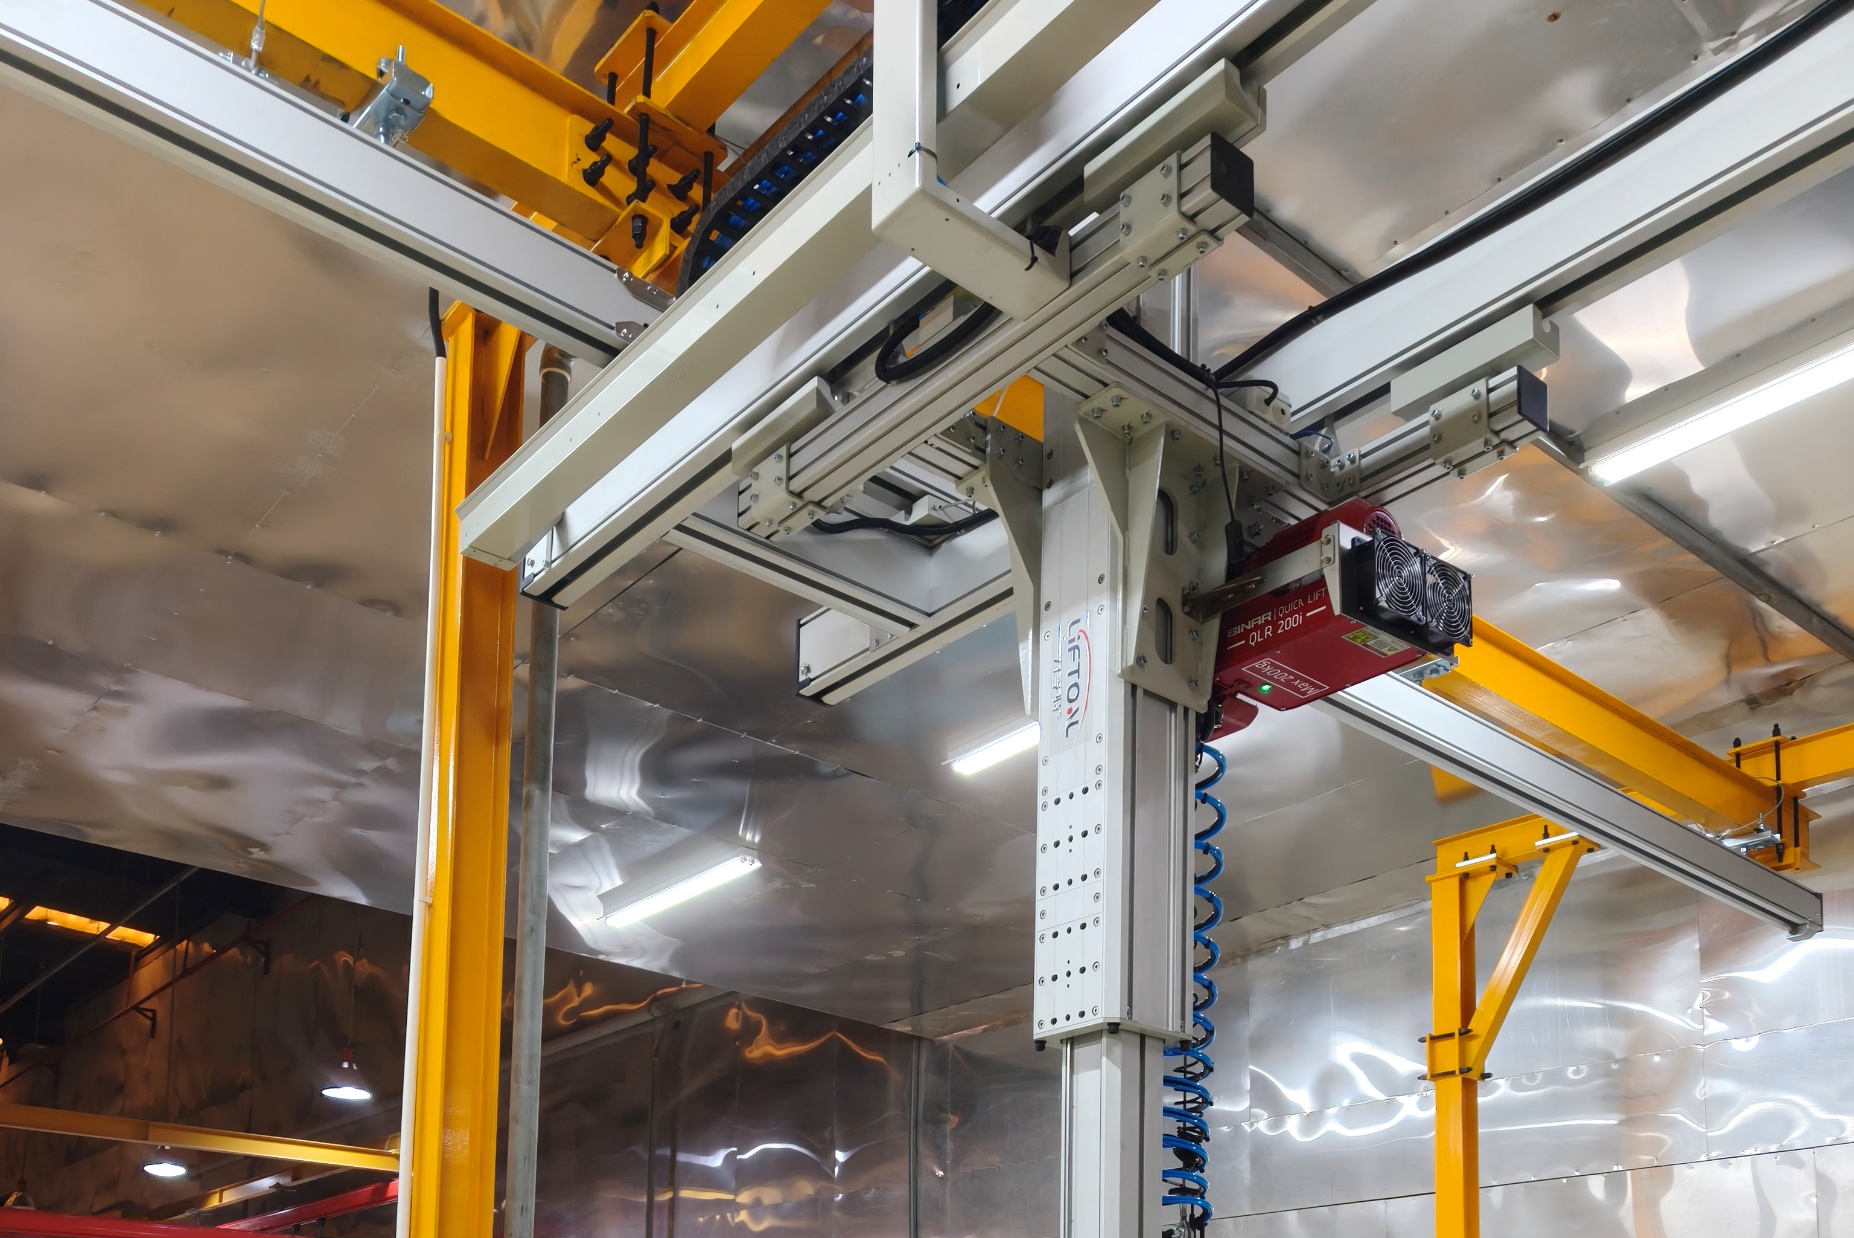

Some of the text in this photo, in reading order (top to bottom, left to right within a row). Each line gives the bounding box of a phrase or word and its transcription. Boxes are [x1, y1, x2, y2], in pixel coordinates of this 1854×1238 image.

[1278, 598, 1305, 617] QUICK
[1307, 587, 1327, 604] LIFT
[1249, 612, 1303, 647] QLR 200i
[1254, 660, 1320, 695] Max 200kg
